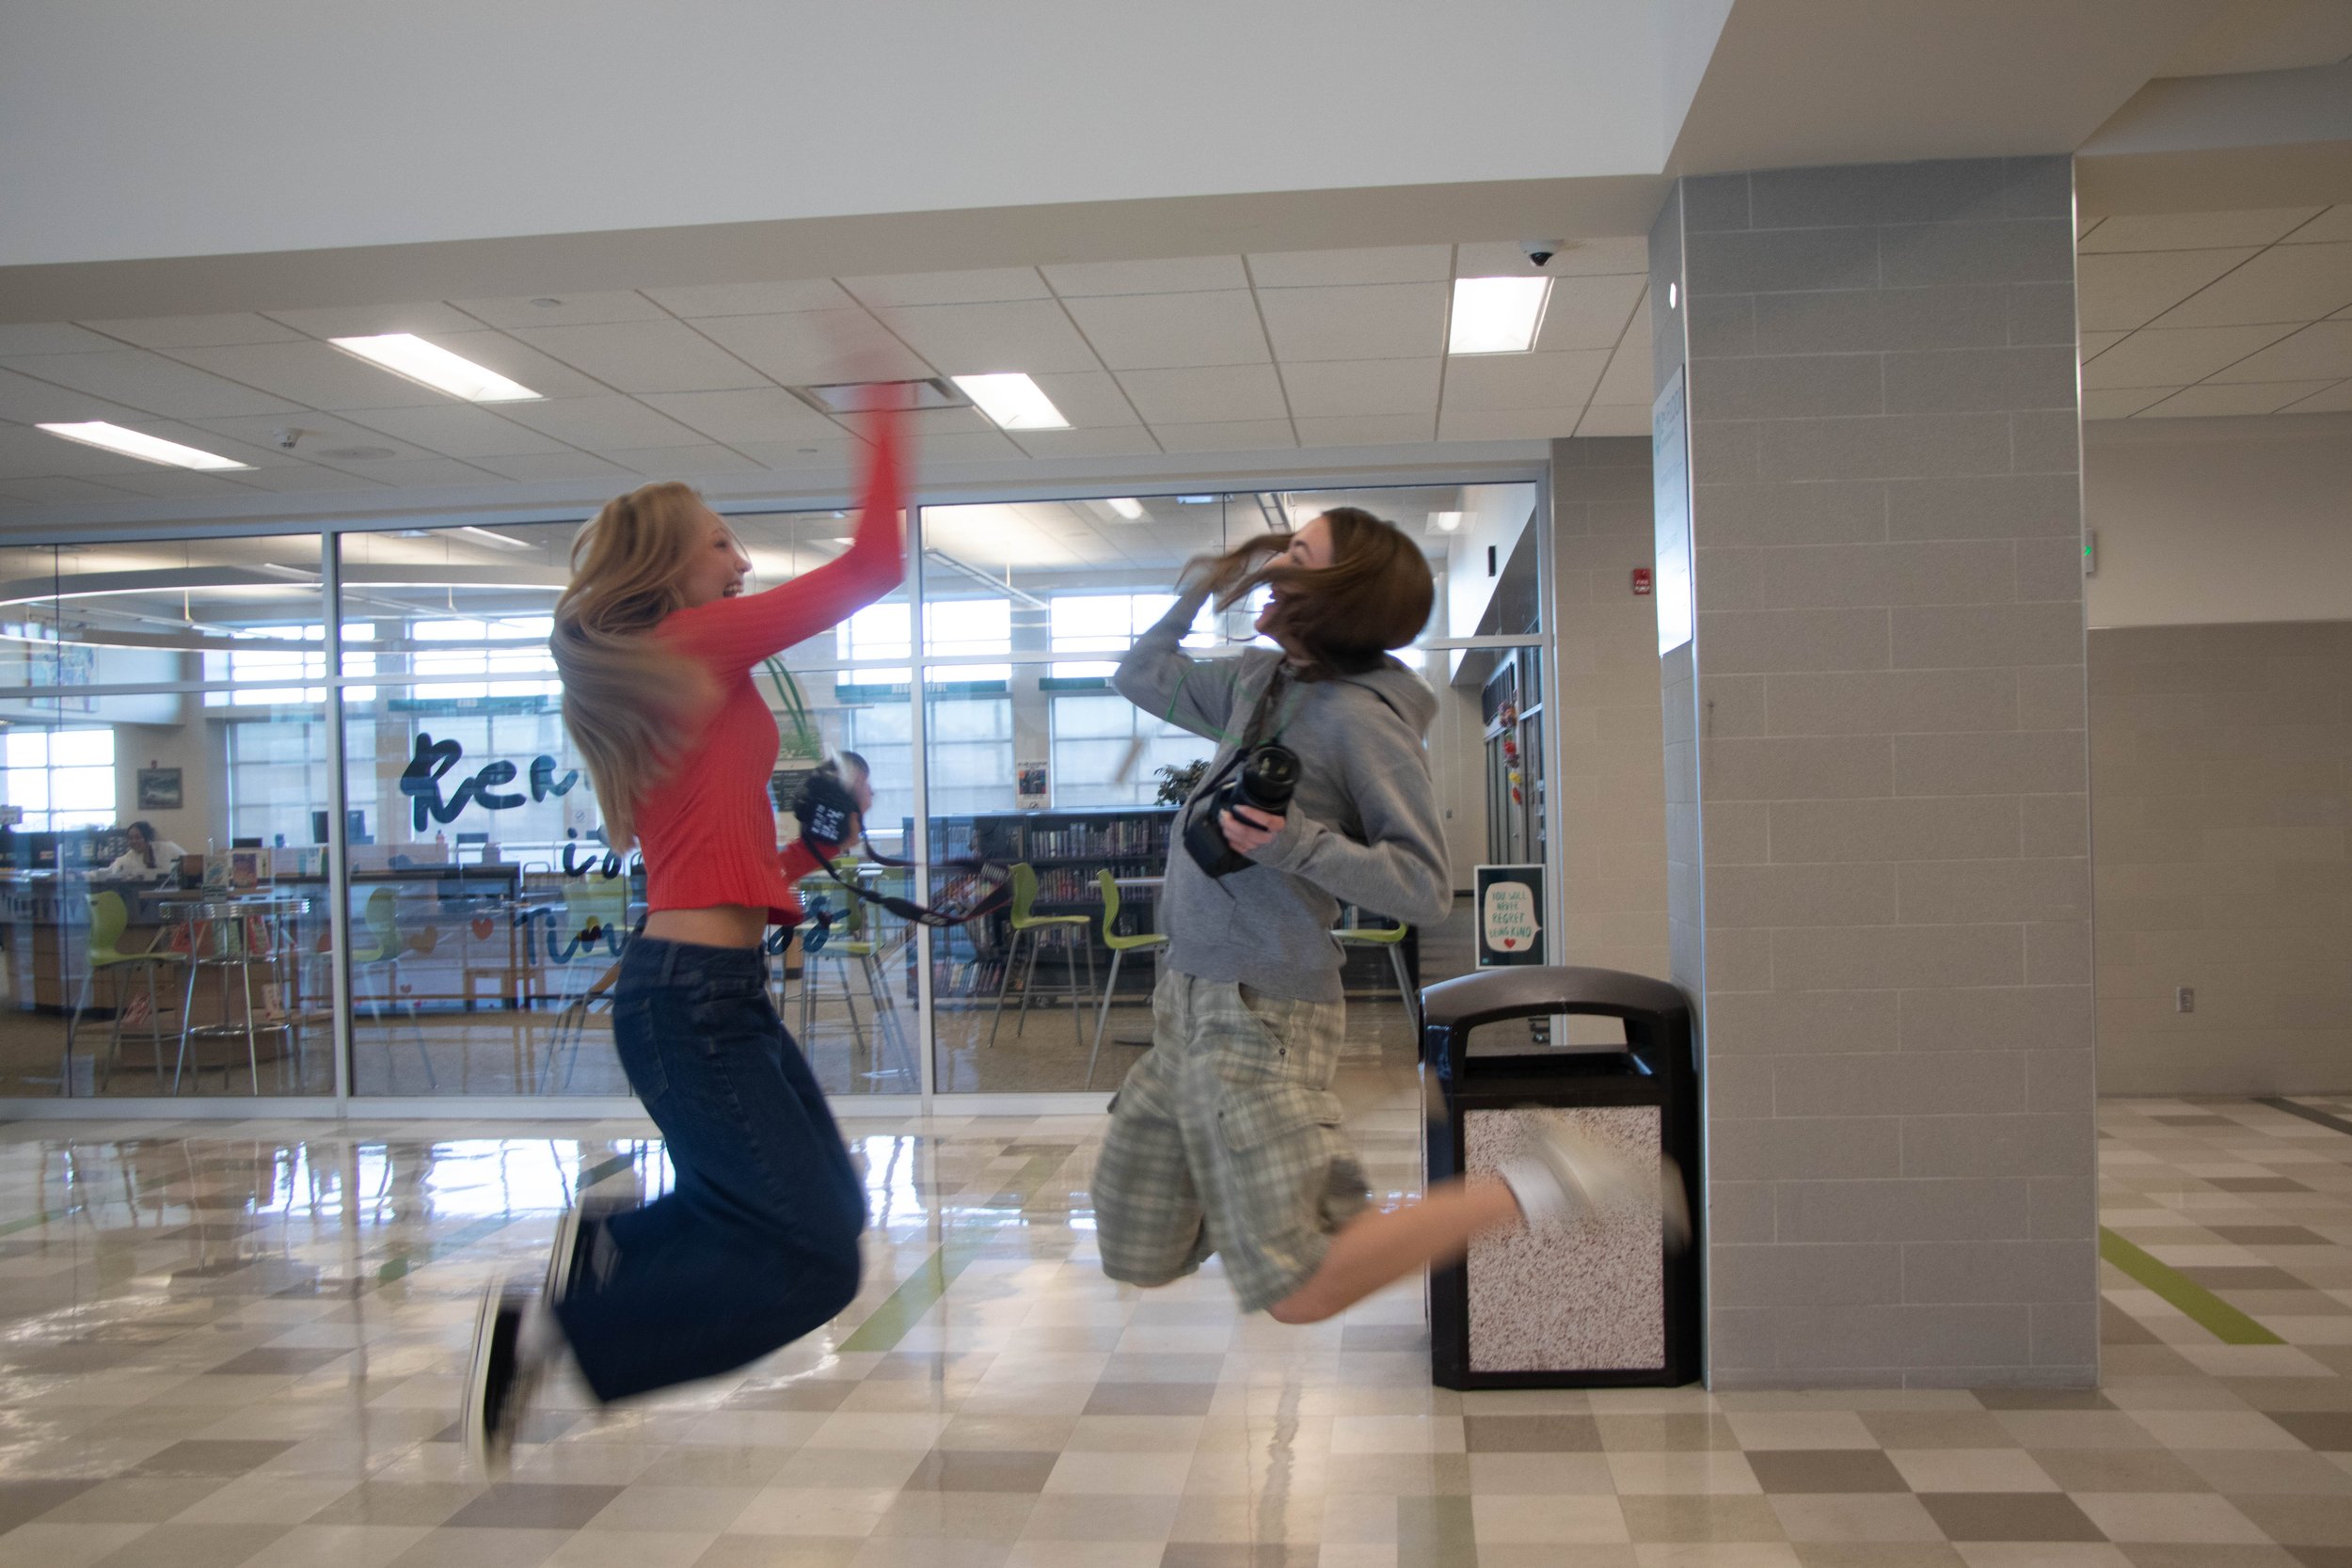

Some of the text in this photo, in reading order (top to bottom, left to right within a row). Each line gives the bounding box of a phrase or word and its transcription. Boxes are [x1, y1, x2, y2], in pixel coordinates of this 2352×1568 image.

[1492, 892, 1505, 901] YOU
[1492, 911, 1525, 924] REGRET
[1511, 926, 1532, 938] KIND
